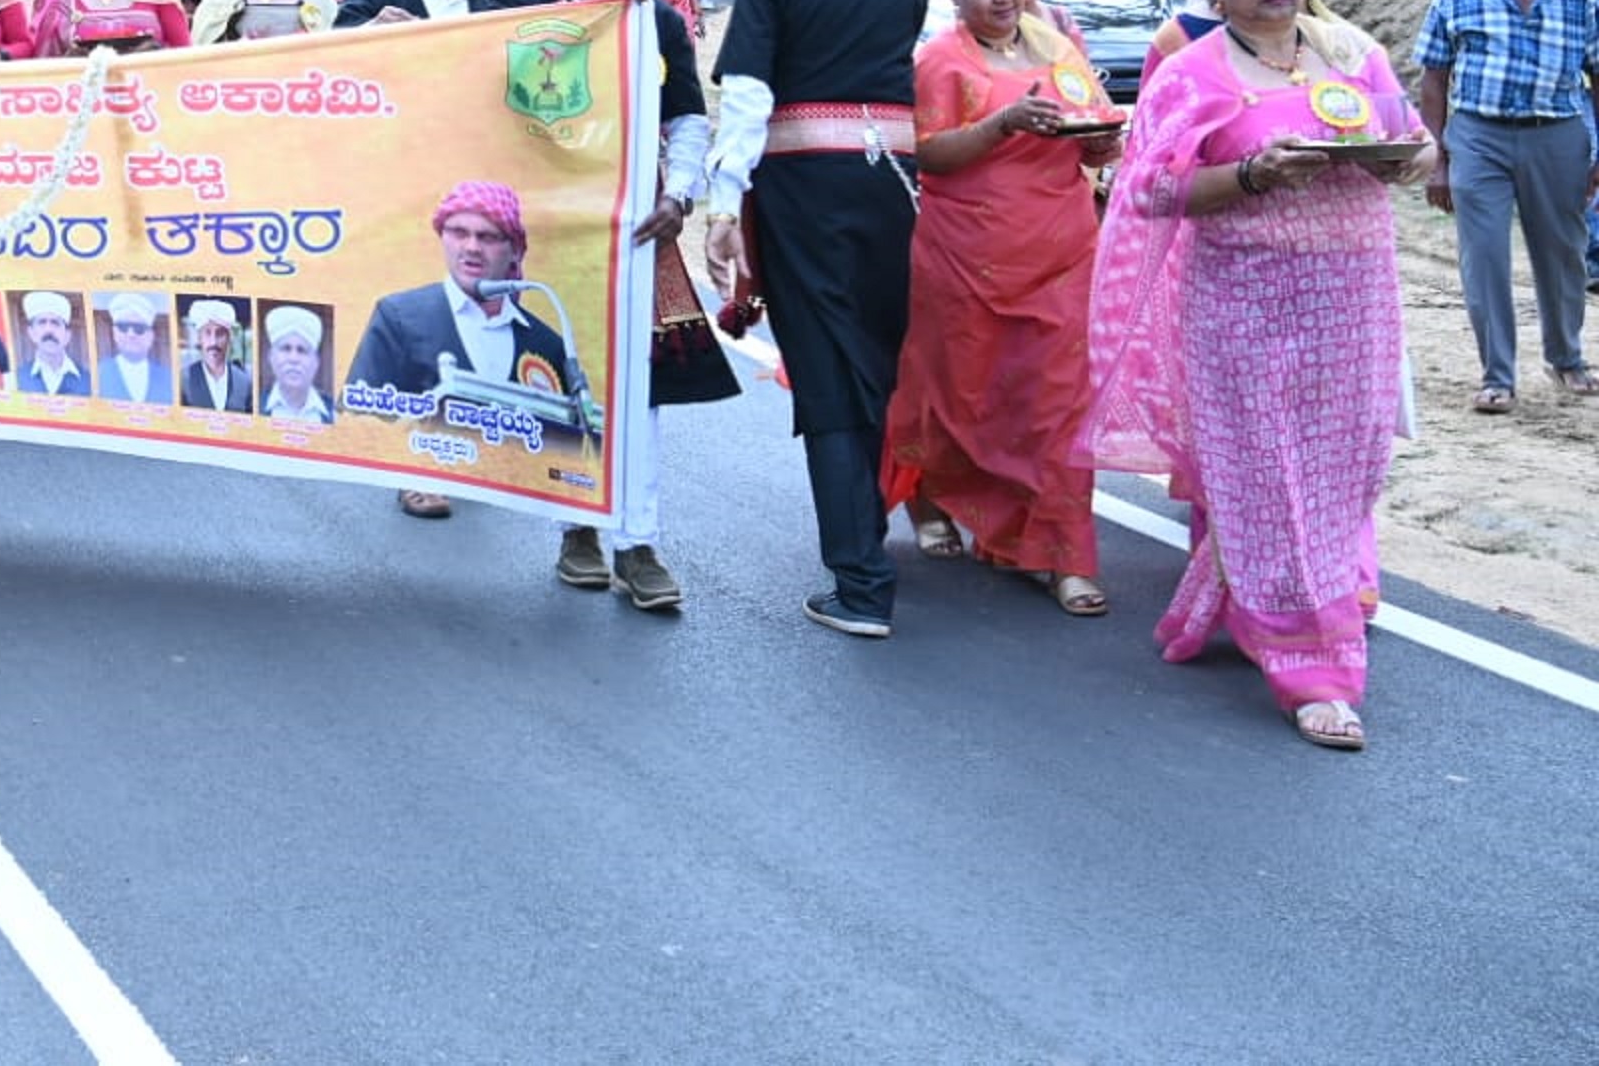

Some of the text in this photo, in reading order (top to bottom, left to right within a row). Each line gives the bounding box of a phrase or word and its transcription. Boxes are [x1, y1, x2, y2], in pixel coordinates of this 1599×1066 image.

[179, 70, 395, 114] ಅಕಾಡೆಮಿ.
[128, 146, 225, 199] ಕುಟ್ಟ
[144, 209, 343, 275] ತಕ್ಕಾರ
[346, 385, 437, 416] ಮಹೇಶ್
